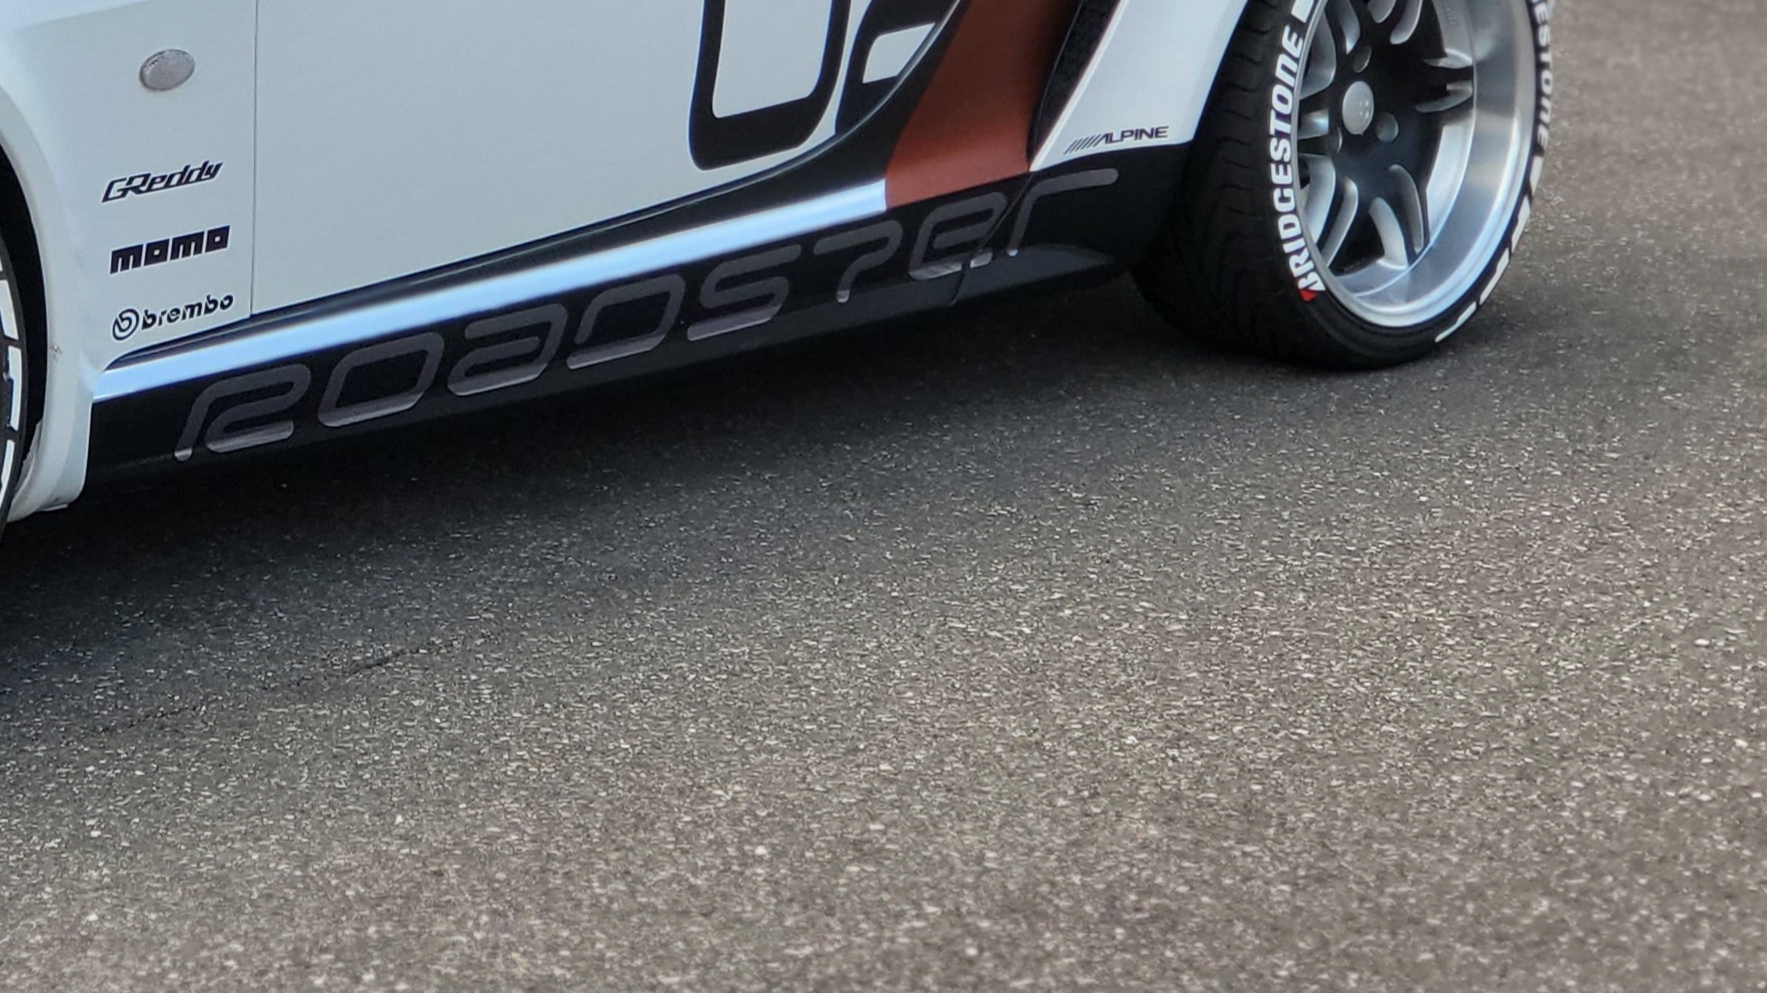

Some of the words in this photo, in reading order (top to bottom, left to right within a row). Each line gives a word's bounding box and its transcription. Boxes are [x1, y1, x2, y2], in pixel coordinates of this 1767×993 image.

[101, 160, 223, 203] GReddy
[1270, 25, 1325, 300] BRIDGESTONE
[141, 292, 234, 331] brembo
